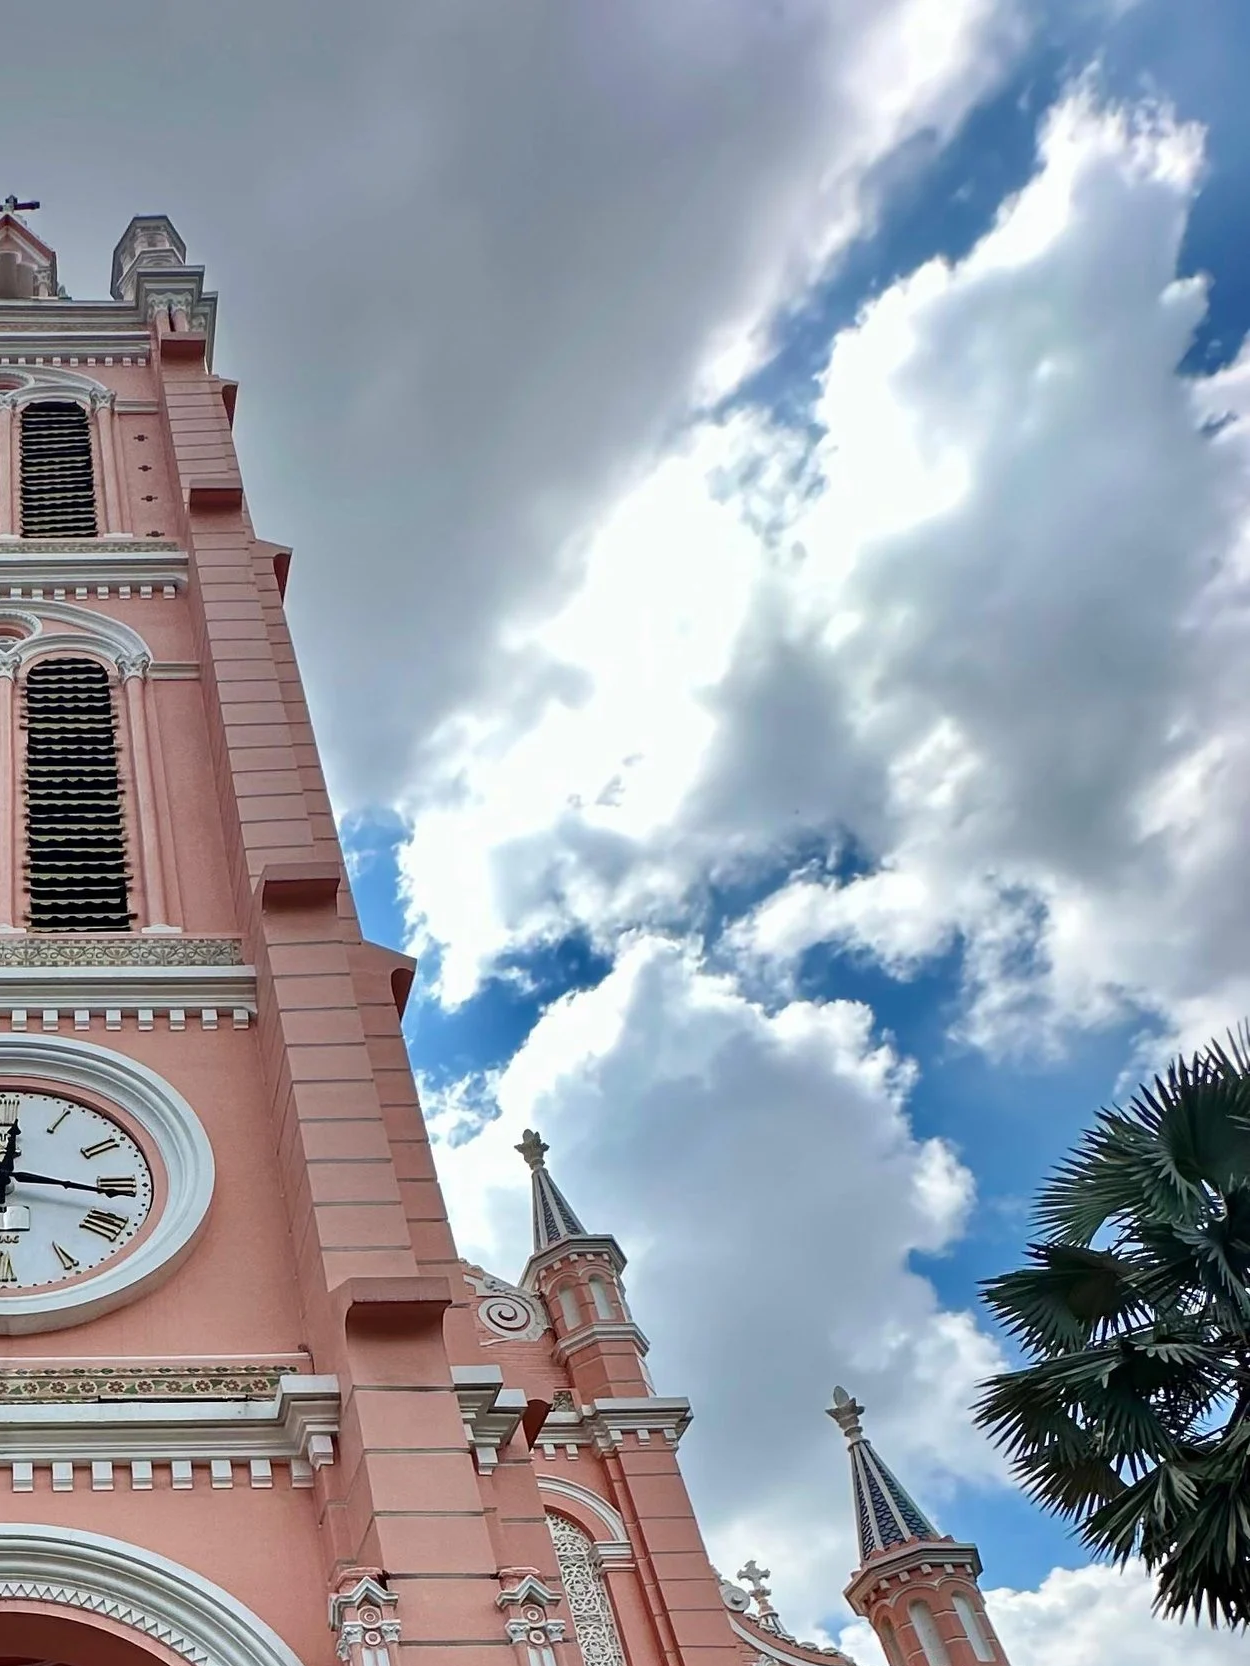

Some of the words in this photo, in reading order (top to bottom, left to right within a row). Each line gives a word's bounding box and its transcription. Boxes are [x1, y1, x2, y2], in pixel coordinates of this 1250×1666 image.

[46, 1108, 71, 1134] I
[80, 1135, 120, 1160] II
[96, 1174, 137, 1198] III
[51, 1240, 80, 1270] V
